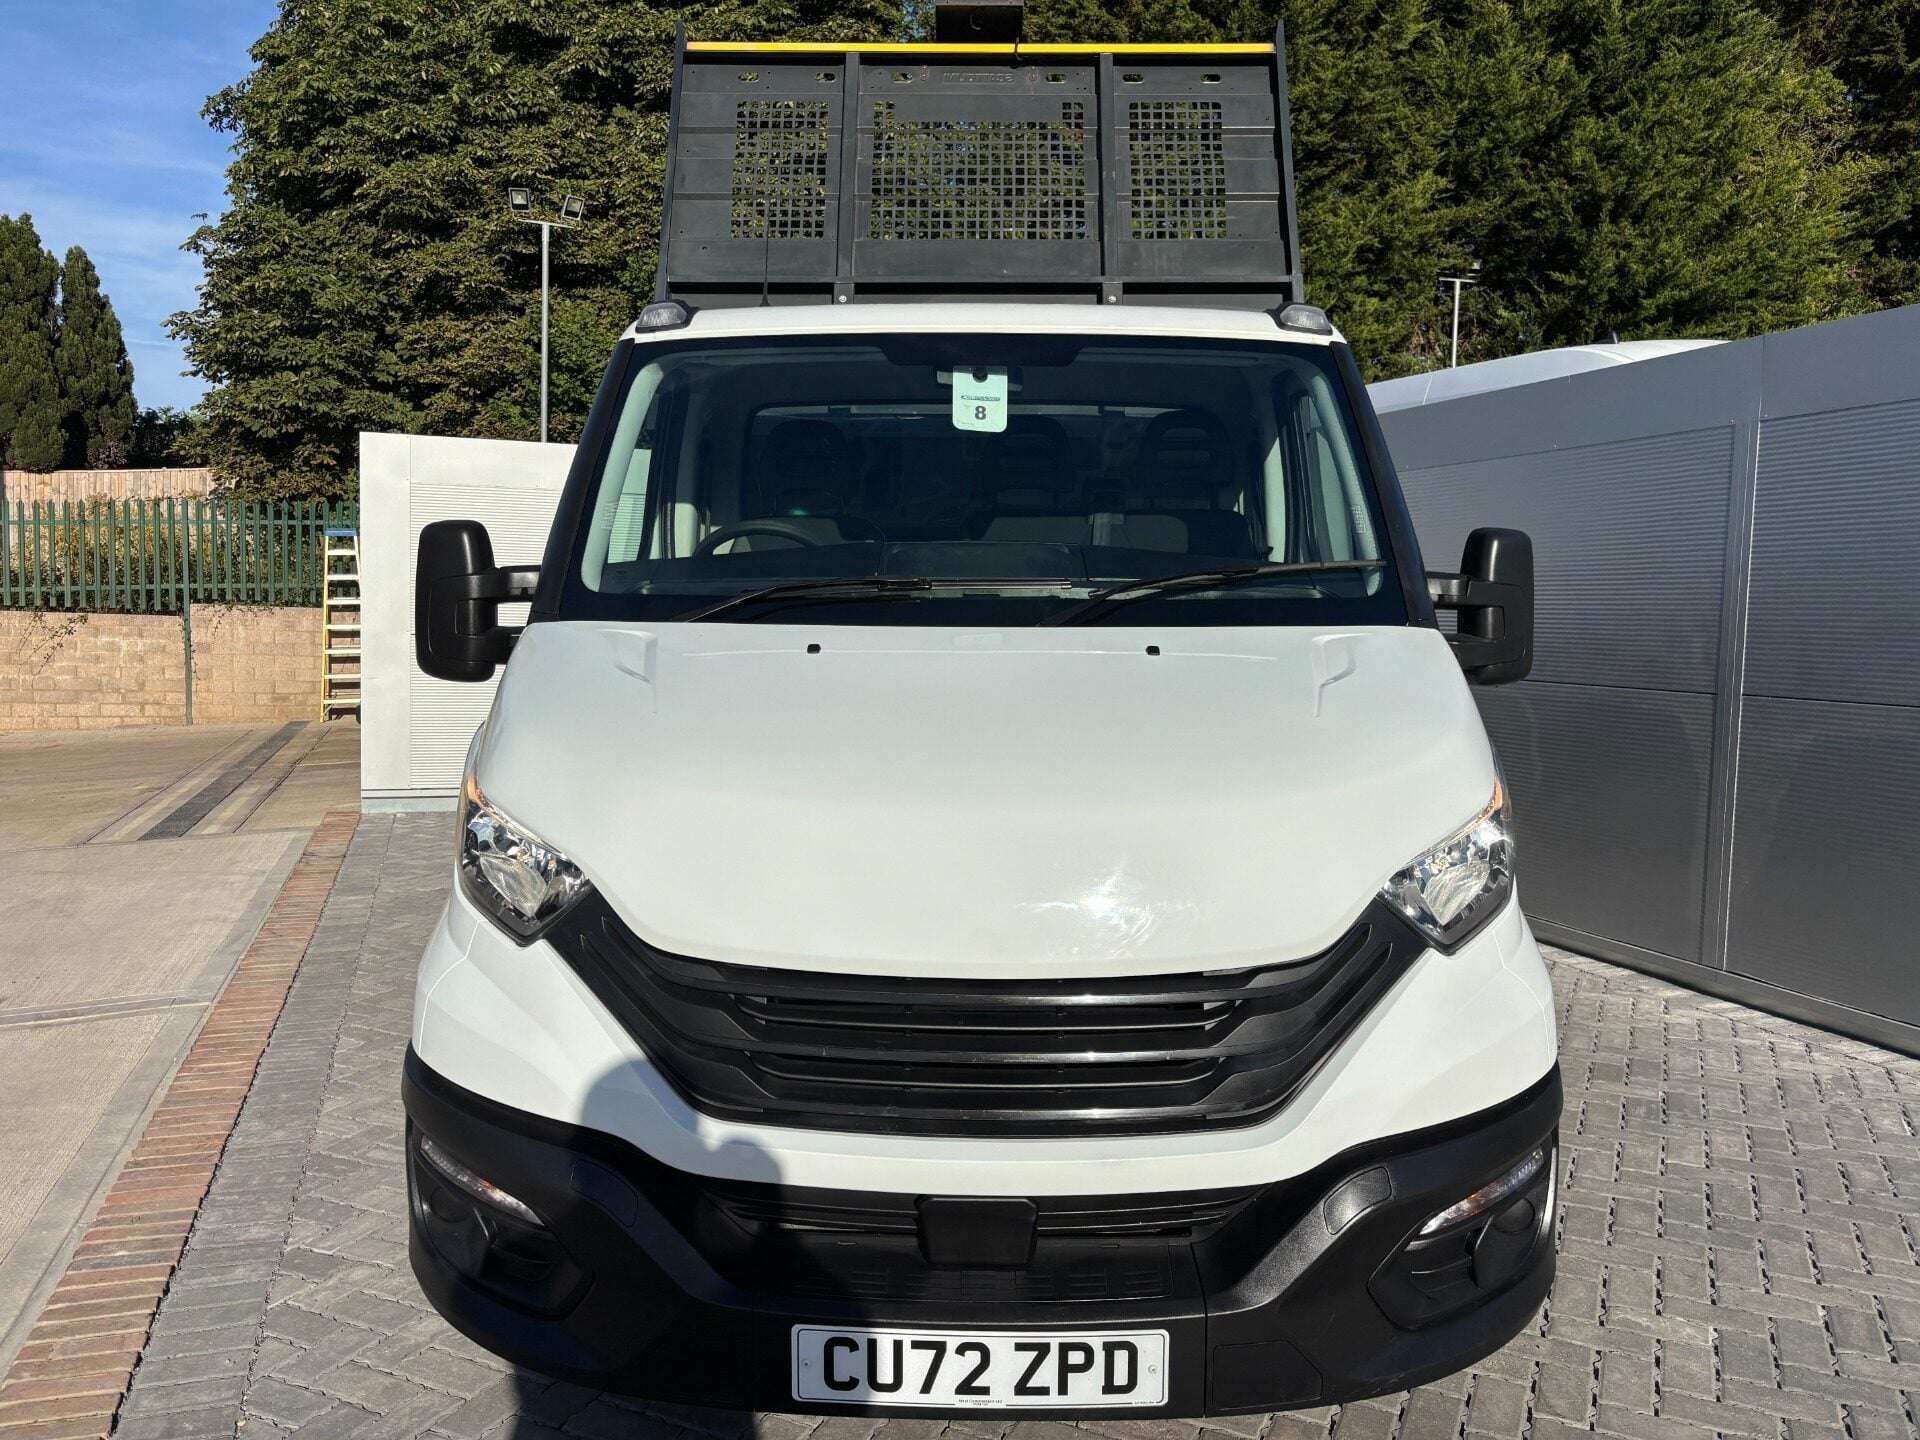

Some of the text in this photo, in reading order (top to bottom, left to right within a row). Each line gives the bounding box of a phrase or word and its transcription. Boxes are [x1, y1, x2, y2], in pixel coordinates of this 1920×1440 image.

[975, 405, 987, 420] 8
[823, 1336, 1138, 1396] CU72 ZPD
